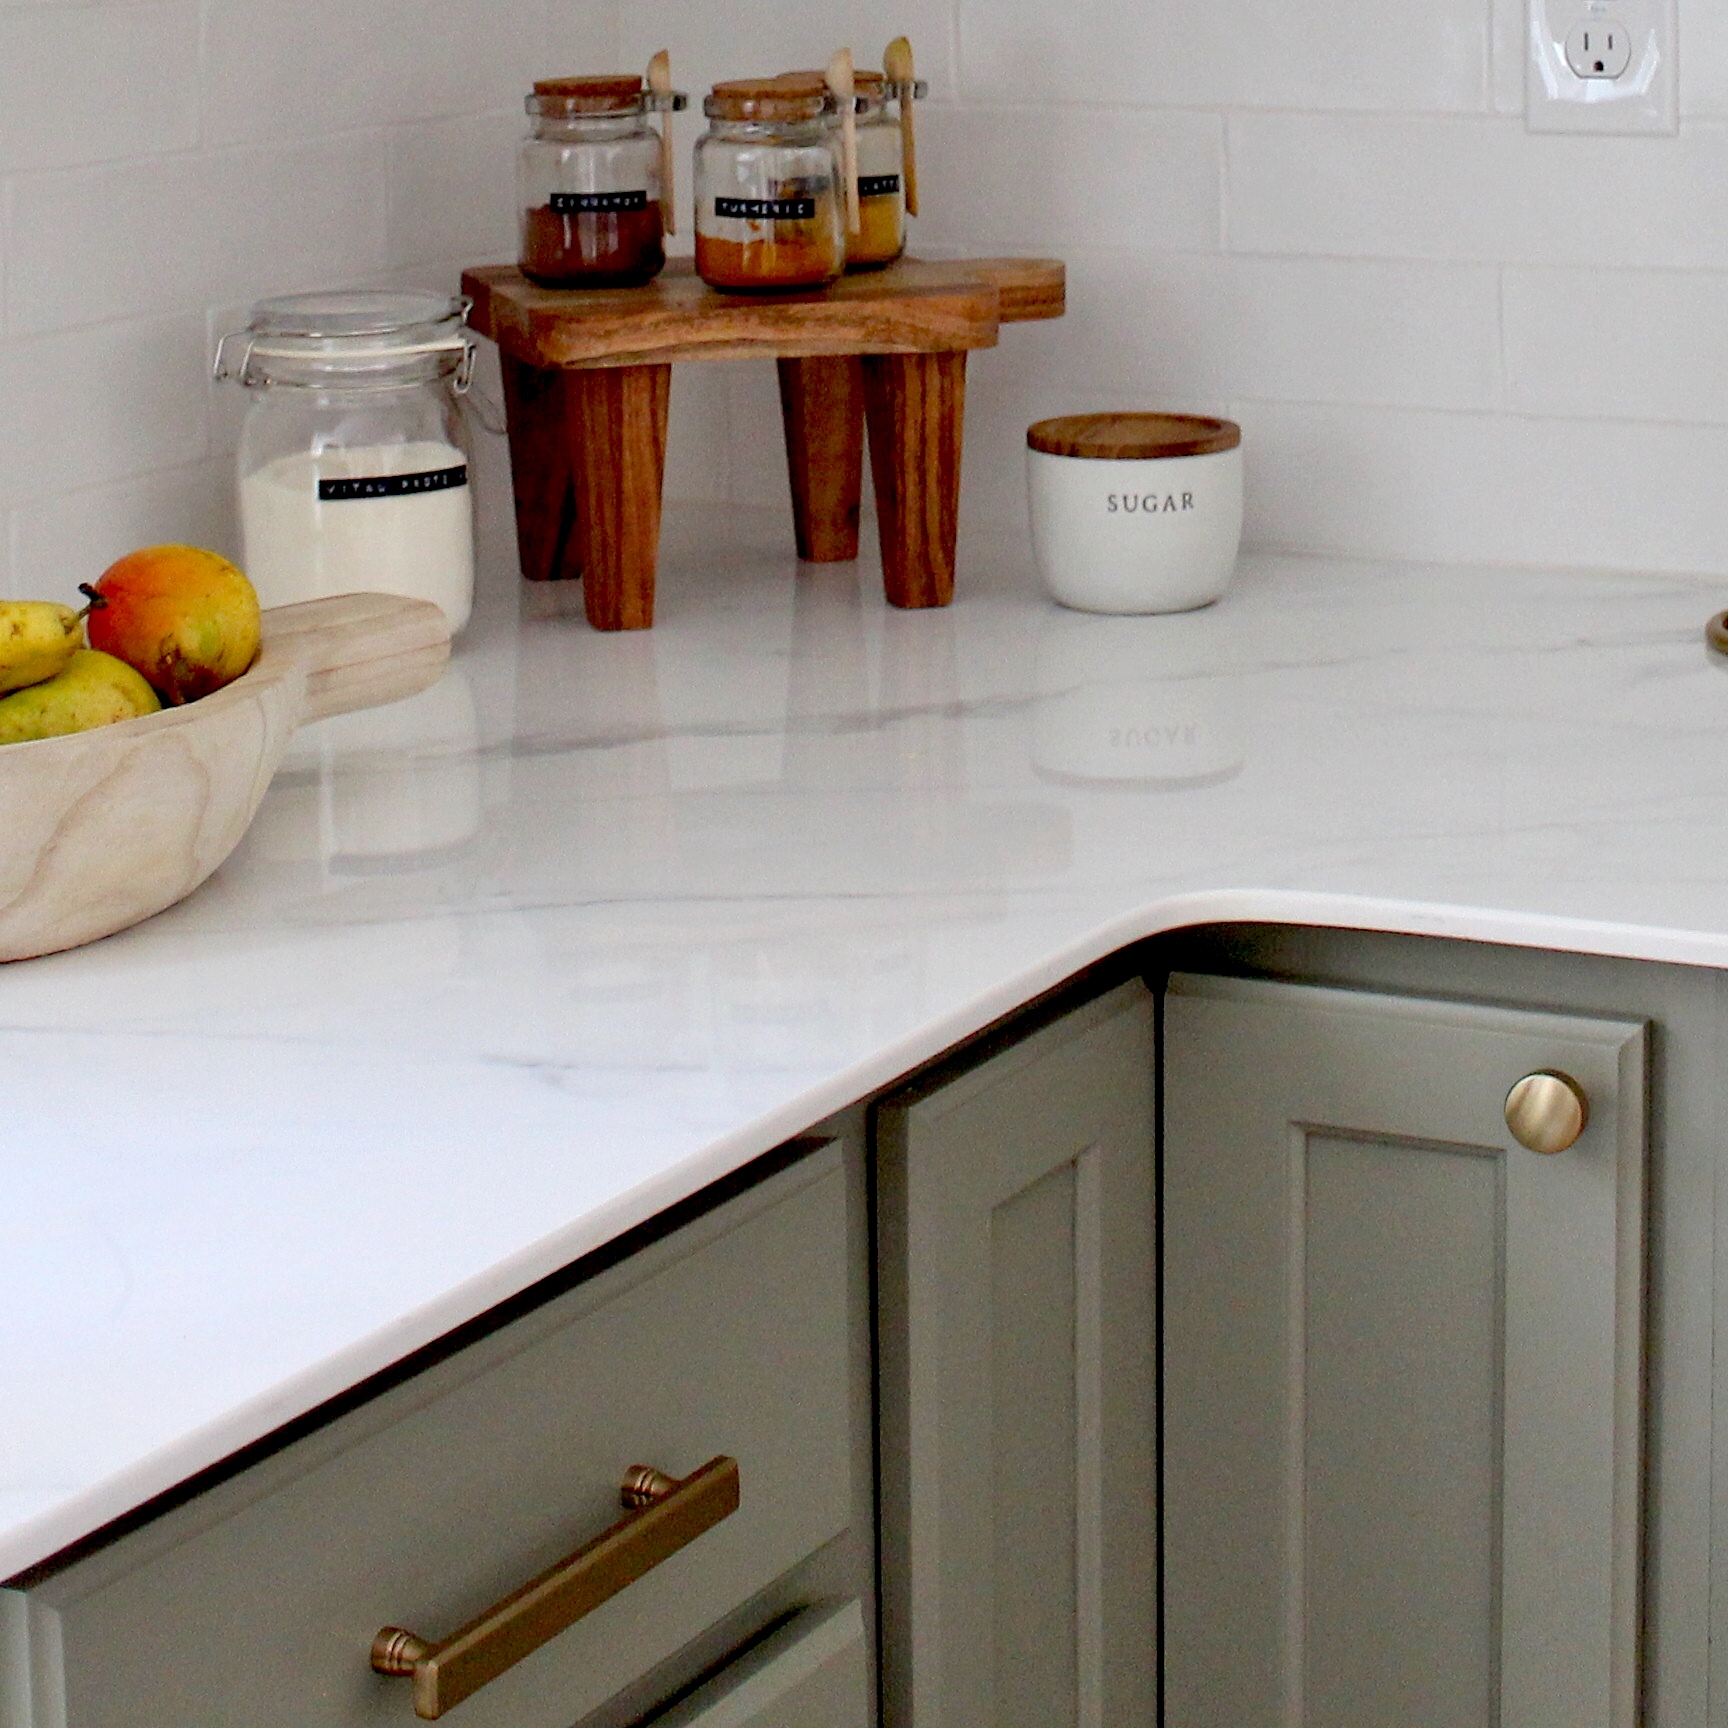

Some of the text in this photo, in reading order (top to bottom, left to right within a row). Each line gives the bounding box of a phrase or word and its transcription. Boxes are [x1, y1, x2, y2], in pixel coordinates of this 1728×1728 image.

[721, 202, 805, 215] TURMERIC
[326, 481, 388, 494] VITAL
[1106, 492, 1195, 513] SUGAR
